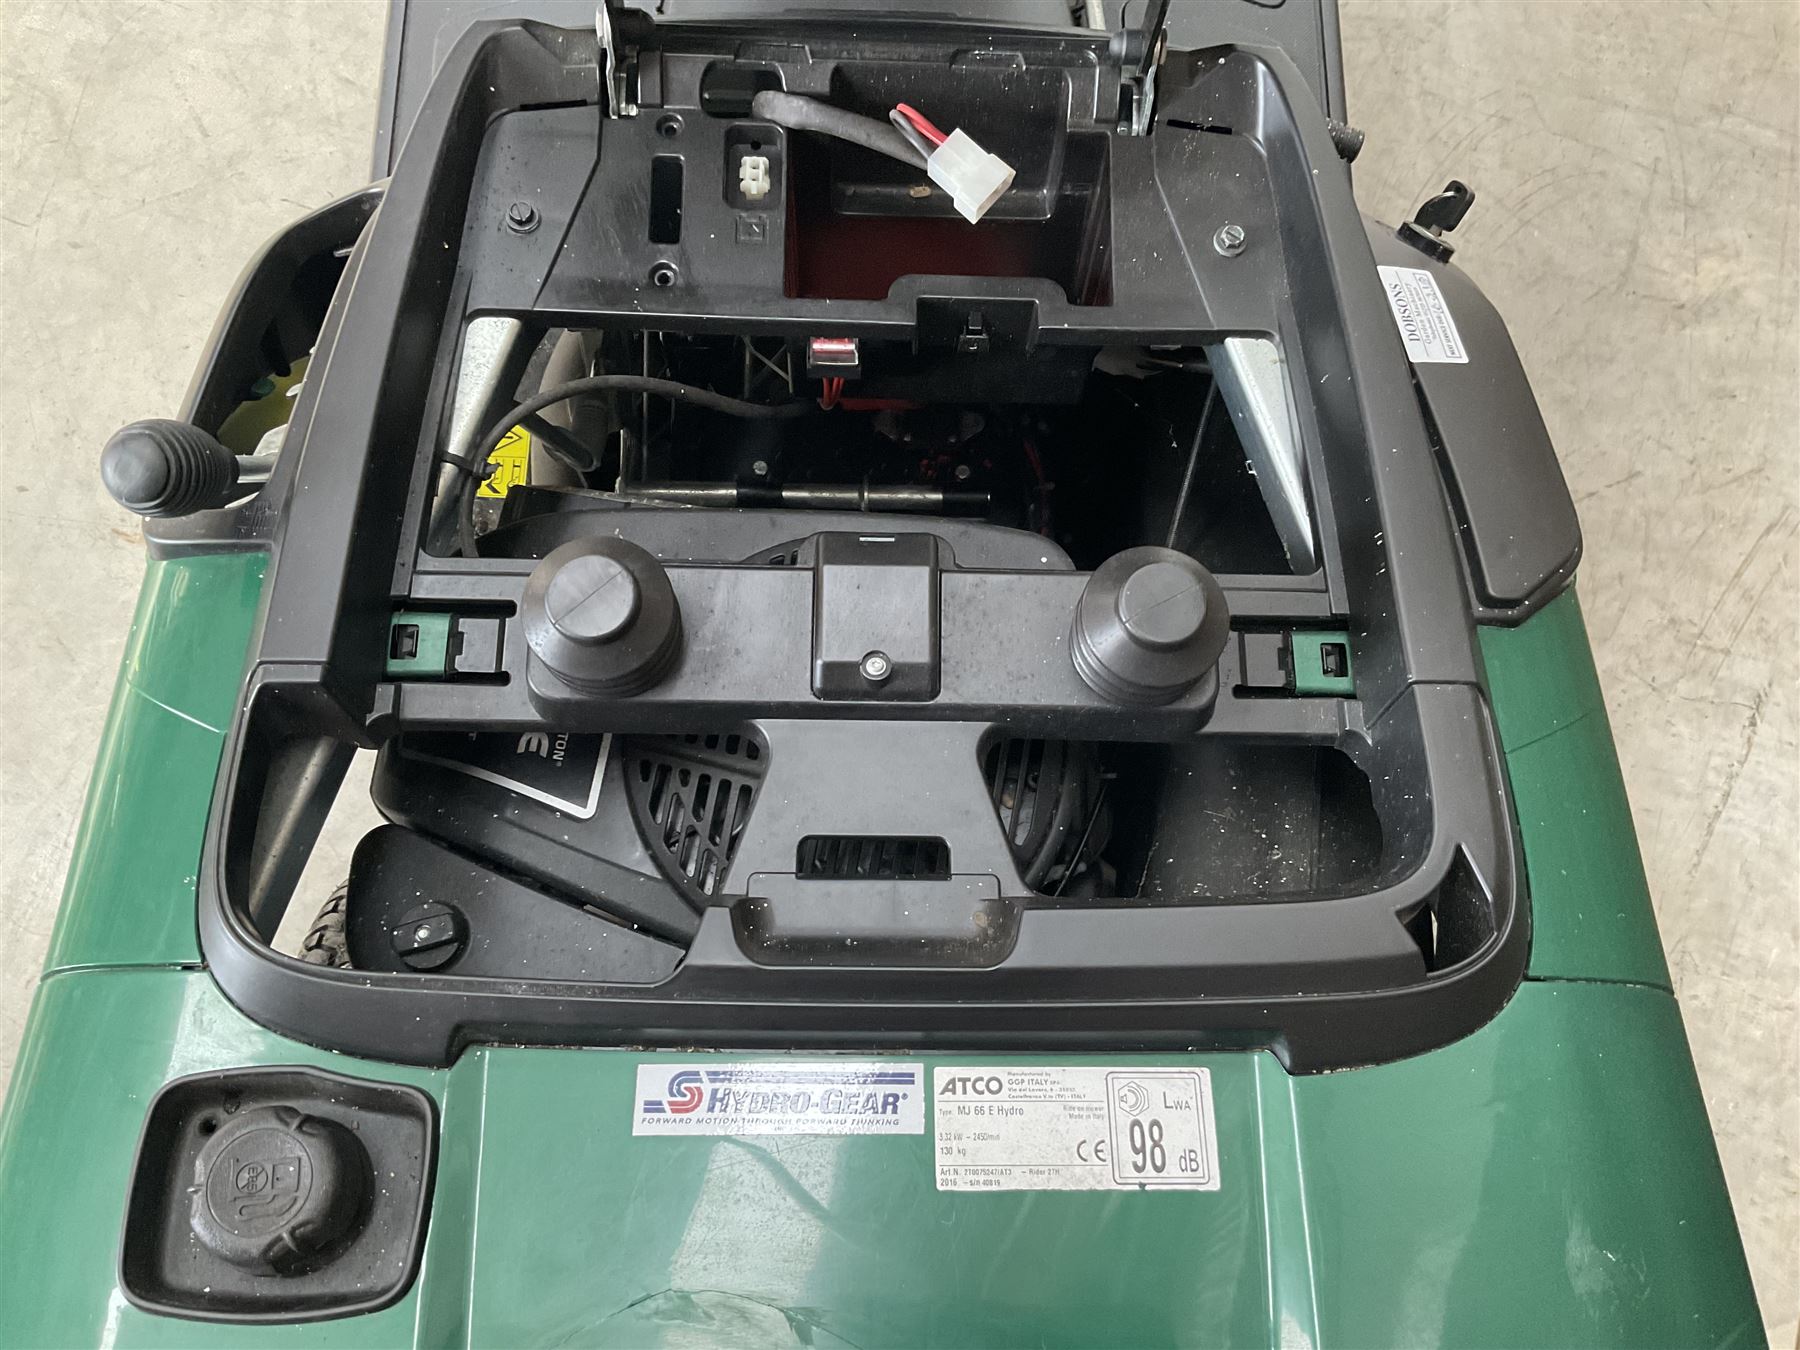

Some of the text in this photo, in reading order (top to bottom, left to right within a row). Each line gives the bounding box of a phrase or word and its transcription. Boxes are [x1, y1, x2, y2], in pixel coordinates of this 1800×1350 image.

[1389, 283, 1421, 341] DOBSONS
[939, 1076, 1003, 1096] ATCO
[957, 1105, 971, 1116] MJ
[974, 1105, 985, 1116] 66
[988, 1105, 994, 1116] E
[997, 1105, 1024, 1117] Hydro
[641, 1117, 692, 1125] FORWARD
[696, 1117, 737, 1125] MOTION
[940, 1146, 966, 1157] 130 kg
[1129, 1118, 1166, 1173] 98
[1179, 1148, 1200, 1172] dB
[940, 1178, 958, 1187] 2016
